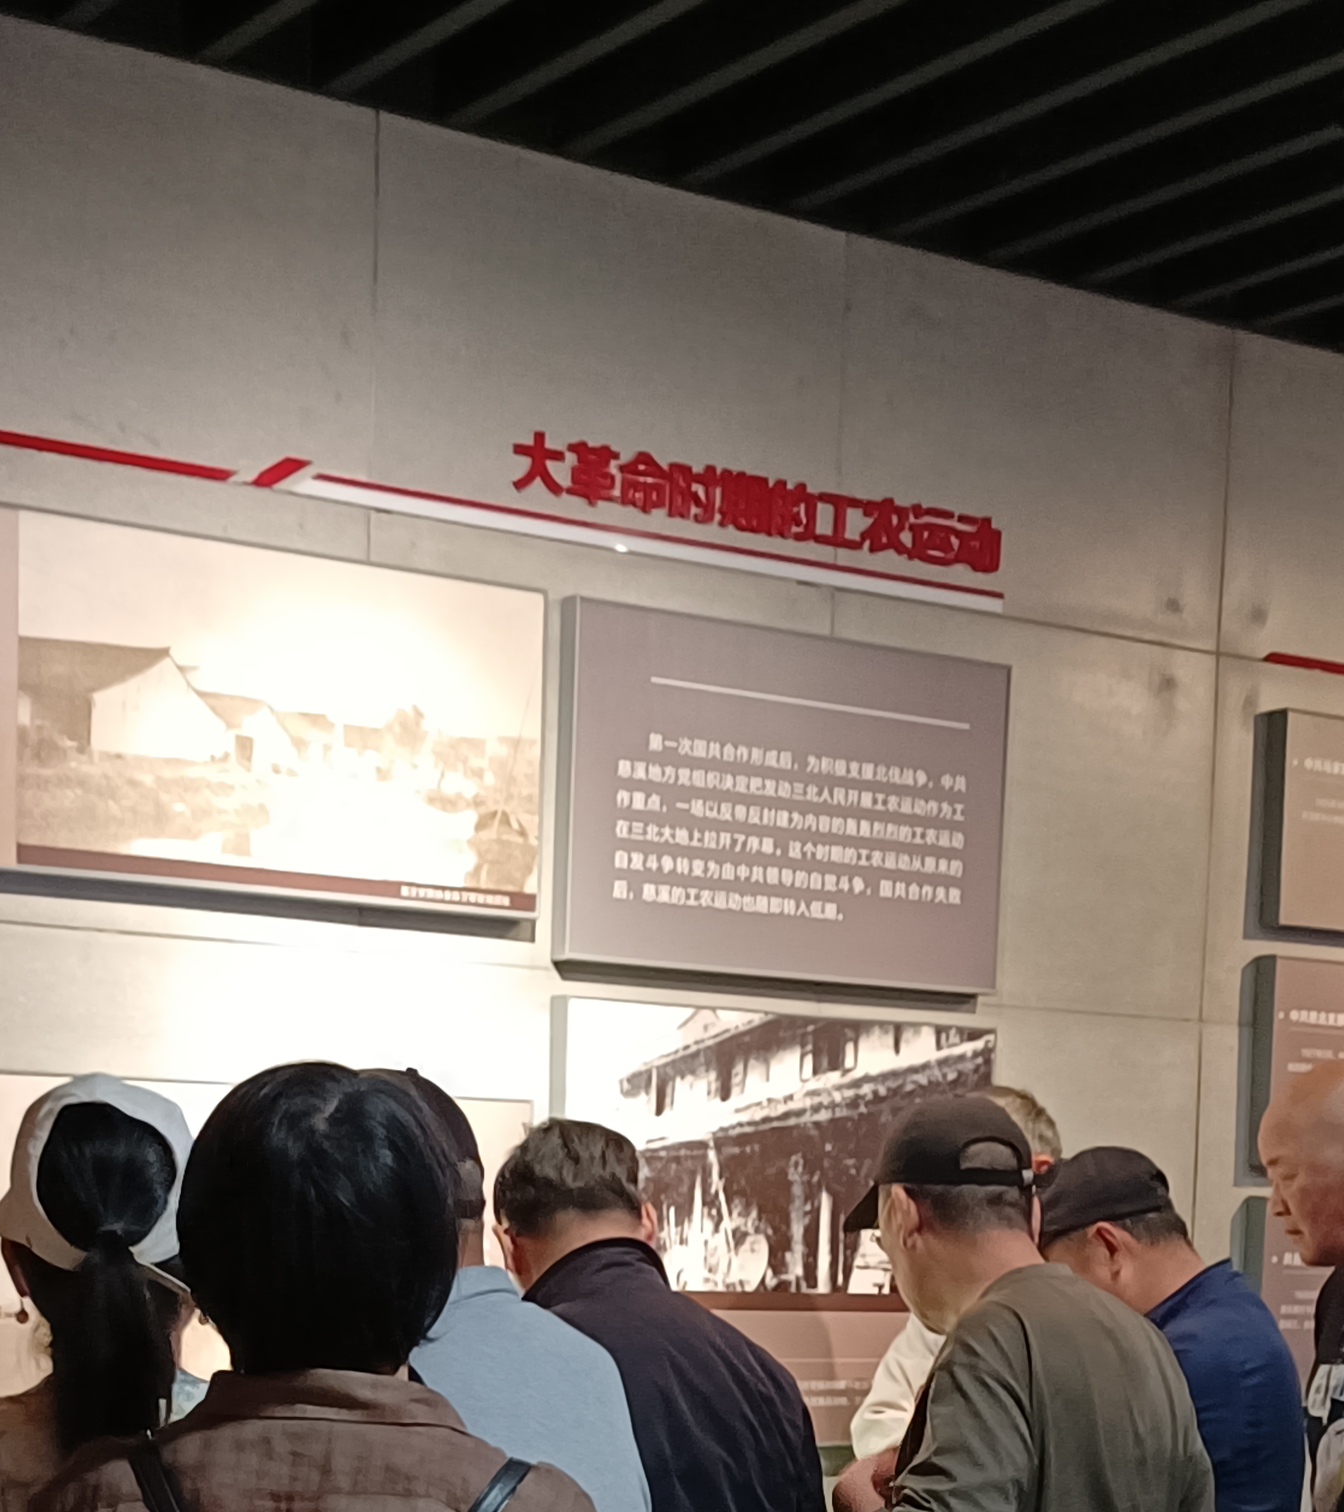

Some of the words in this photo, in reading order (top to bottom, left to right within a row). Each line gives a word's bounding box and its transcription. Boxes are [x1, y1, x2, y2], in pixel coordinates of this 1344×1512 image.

[512, 431, 1002, 573] 大革命时期的工农运动
